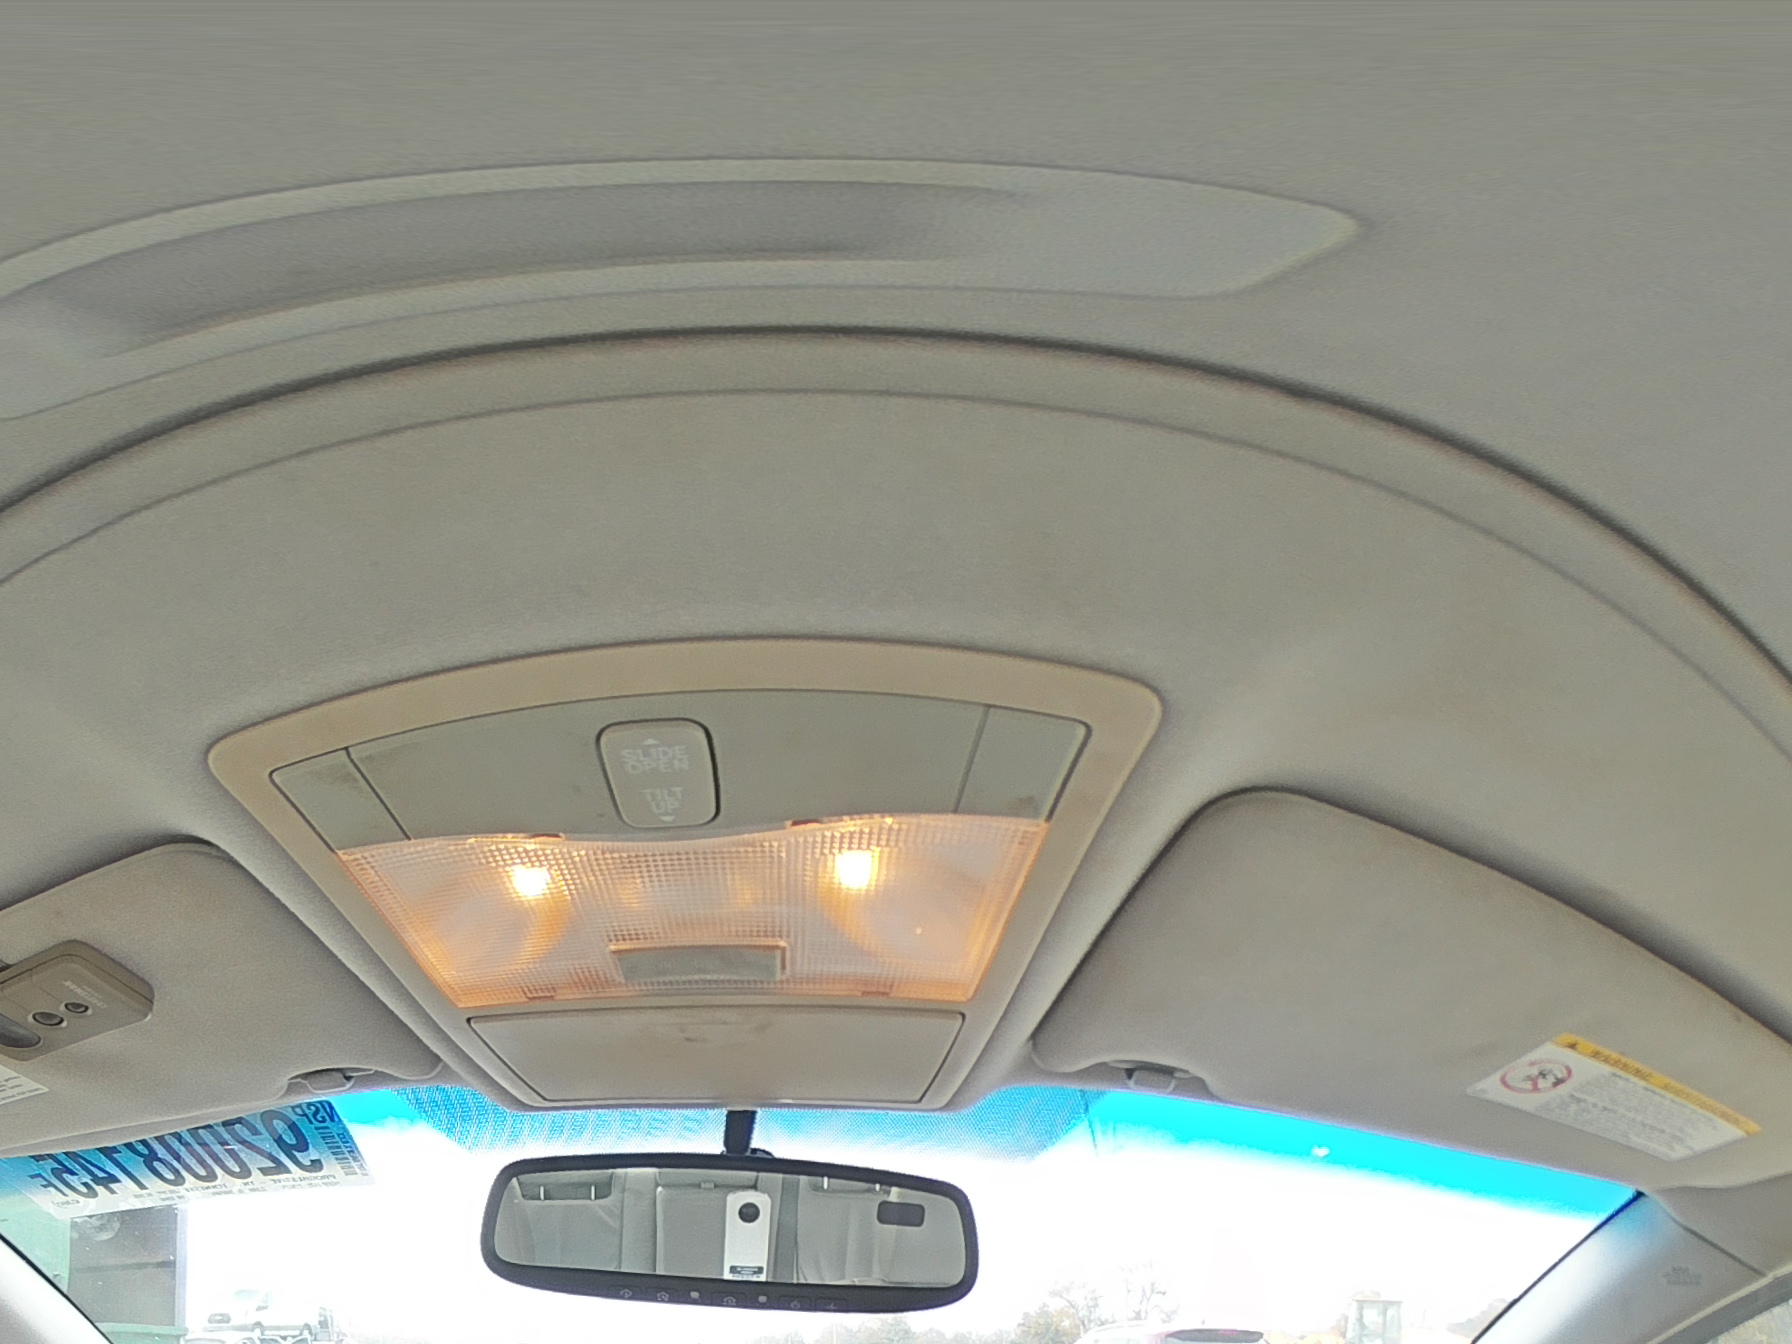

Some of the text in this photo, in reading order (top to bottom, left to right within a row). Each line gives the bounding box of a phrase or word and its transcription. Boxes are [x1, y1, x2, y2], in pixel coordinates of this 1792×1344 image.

[621, 746, 688, 760] SLIDE
[626, 759, 688, 774] OPEN
[652, 801, 679, 814] UP
